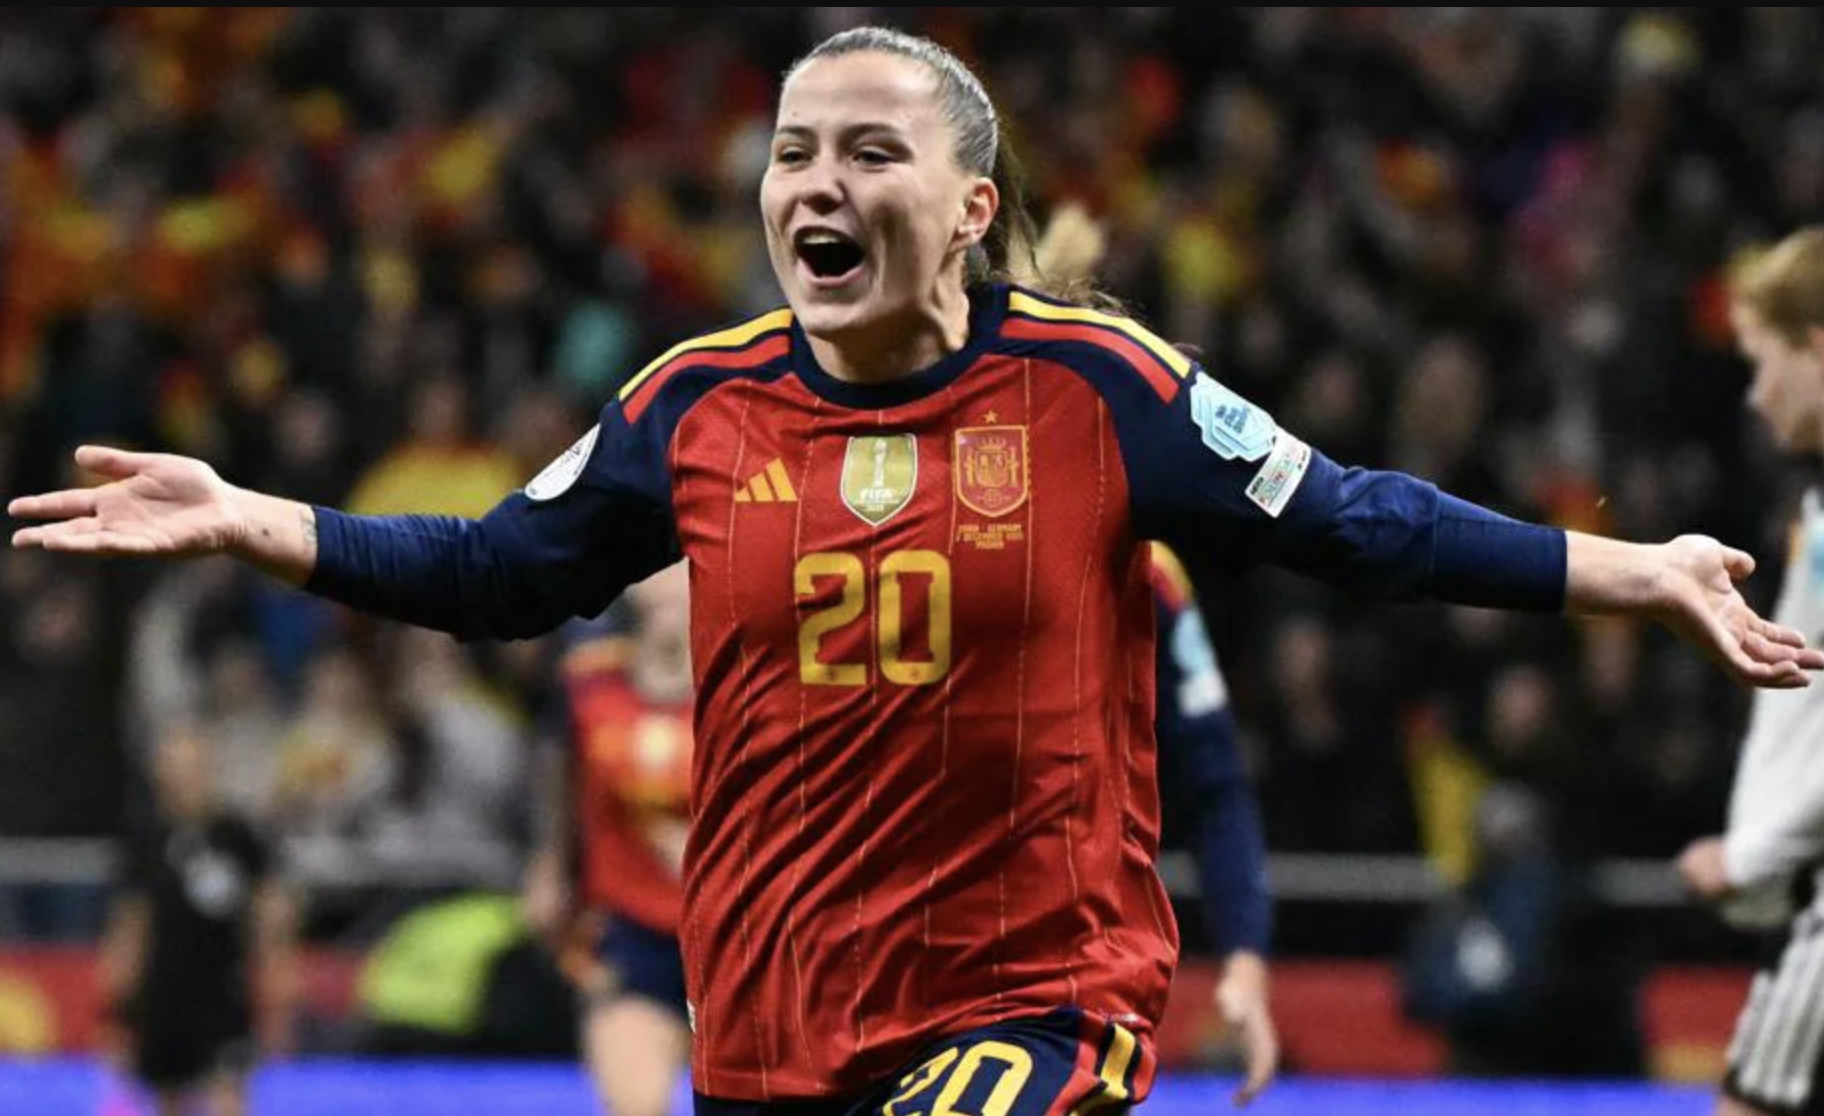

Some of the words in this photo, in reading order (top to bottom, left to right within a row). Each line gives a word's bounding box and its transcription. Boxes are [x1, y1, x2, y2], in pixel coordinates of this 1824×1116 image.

[860, 488, 894, 502] FIFA
[794, 550, 951, 685] 20
[882, 1040, 1033, 1116] 20
